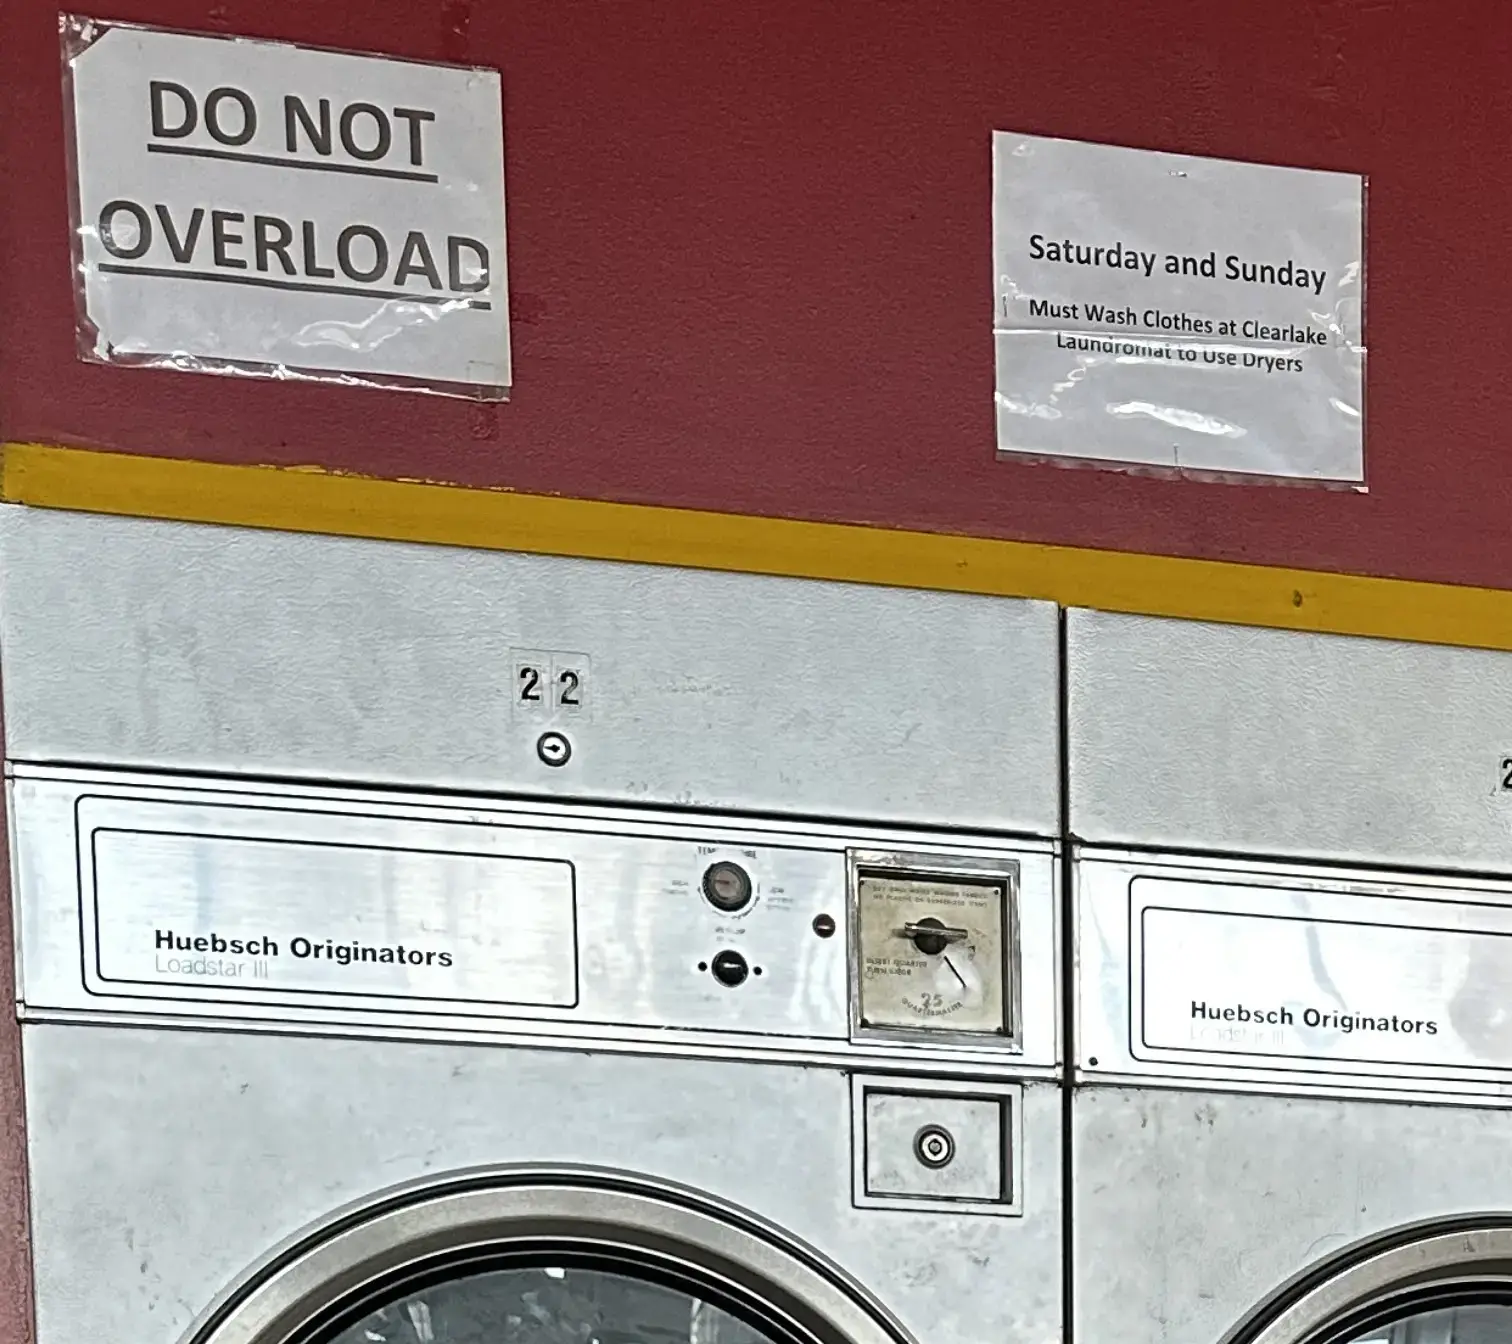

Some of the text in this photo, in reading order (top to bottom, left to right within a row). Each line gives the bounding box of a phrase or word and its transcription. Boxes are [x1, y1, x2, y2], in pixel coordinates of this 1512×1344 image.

[150, 81, 435, 165] DO NOT
[99, 200, 490, 293] OVERLOAD
[1029, 234, 1326, 295] Saturday and Sunday
[1029, 300, 1327, 345] Must Wash Clothes at Clearlake
[1177, 346, 1197, 361] to
[1203, 350, 1237, 365] Use
[1243, 353, 1303, 373] Dryers
[520, 667, 579, 705] 22
[155, 929, 452, 967] Huebsch Originators
[155, 953, 269, 979] Loadstar III
[1191, 1001, 1438, 1035] Huebsch Originators
